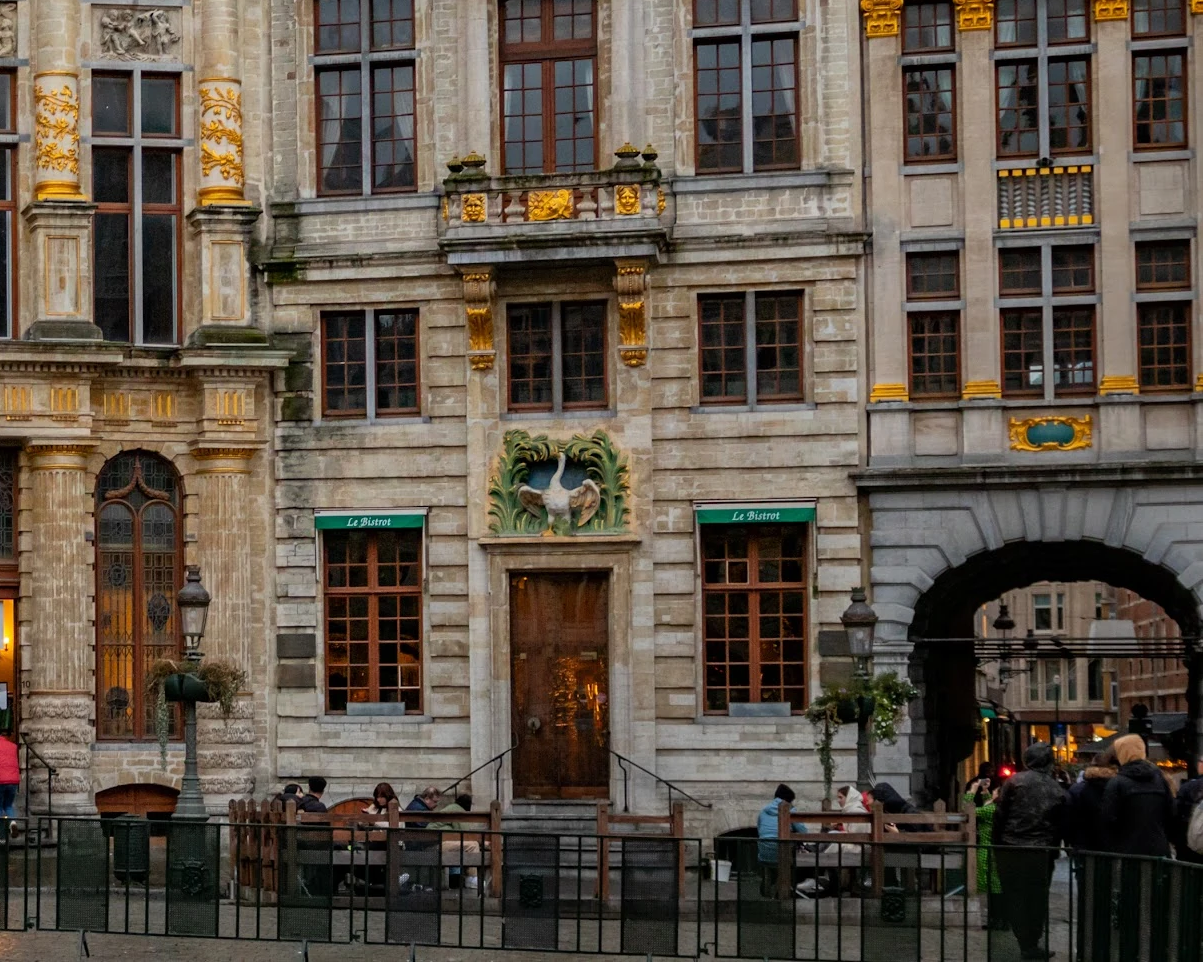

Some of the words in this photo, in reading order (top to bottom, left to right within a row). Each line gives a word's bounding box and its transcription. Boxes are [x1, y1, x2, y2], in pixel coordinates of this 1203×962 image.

[732, 511, 745, 521] Le
[746, 510, 780, 521] Bistrot
[346, 517, 358, 527] Le
[359, 516, 392, 528] Bistrot
[22, 680, 31, 689] 10
